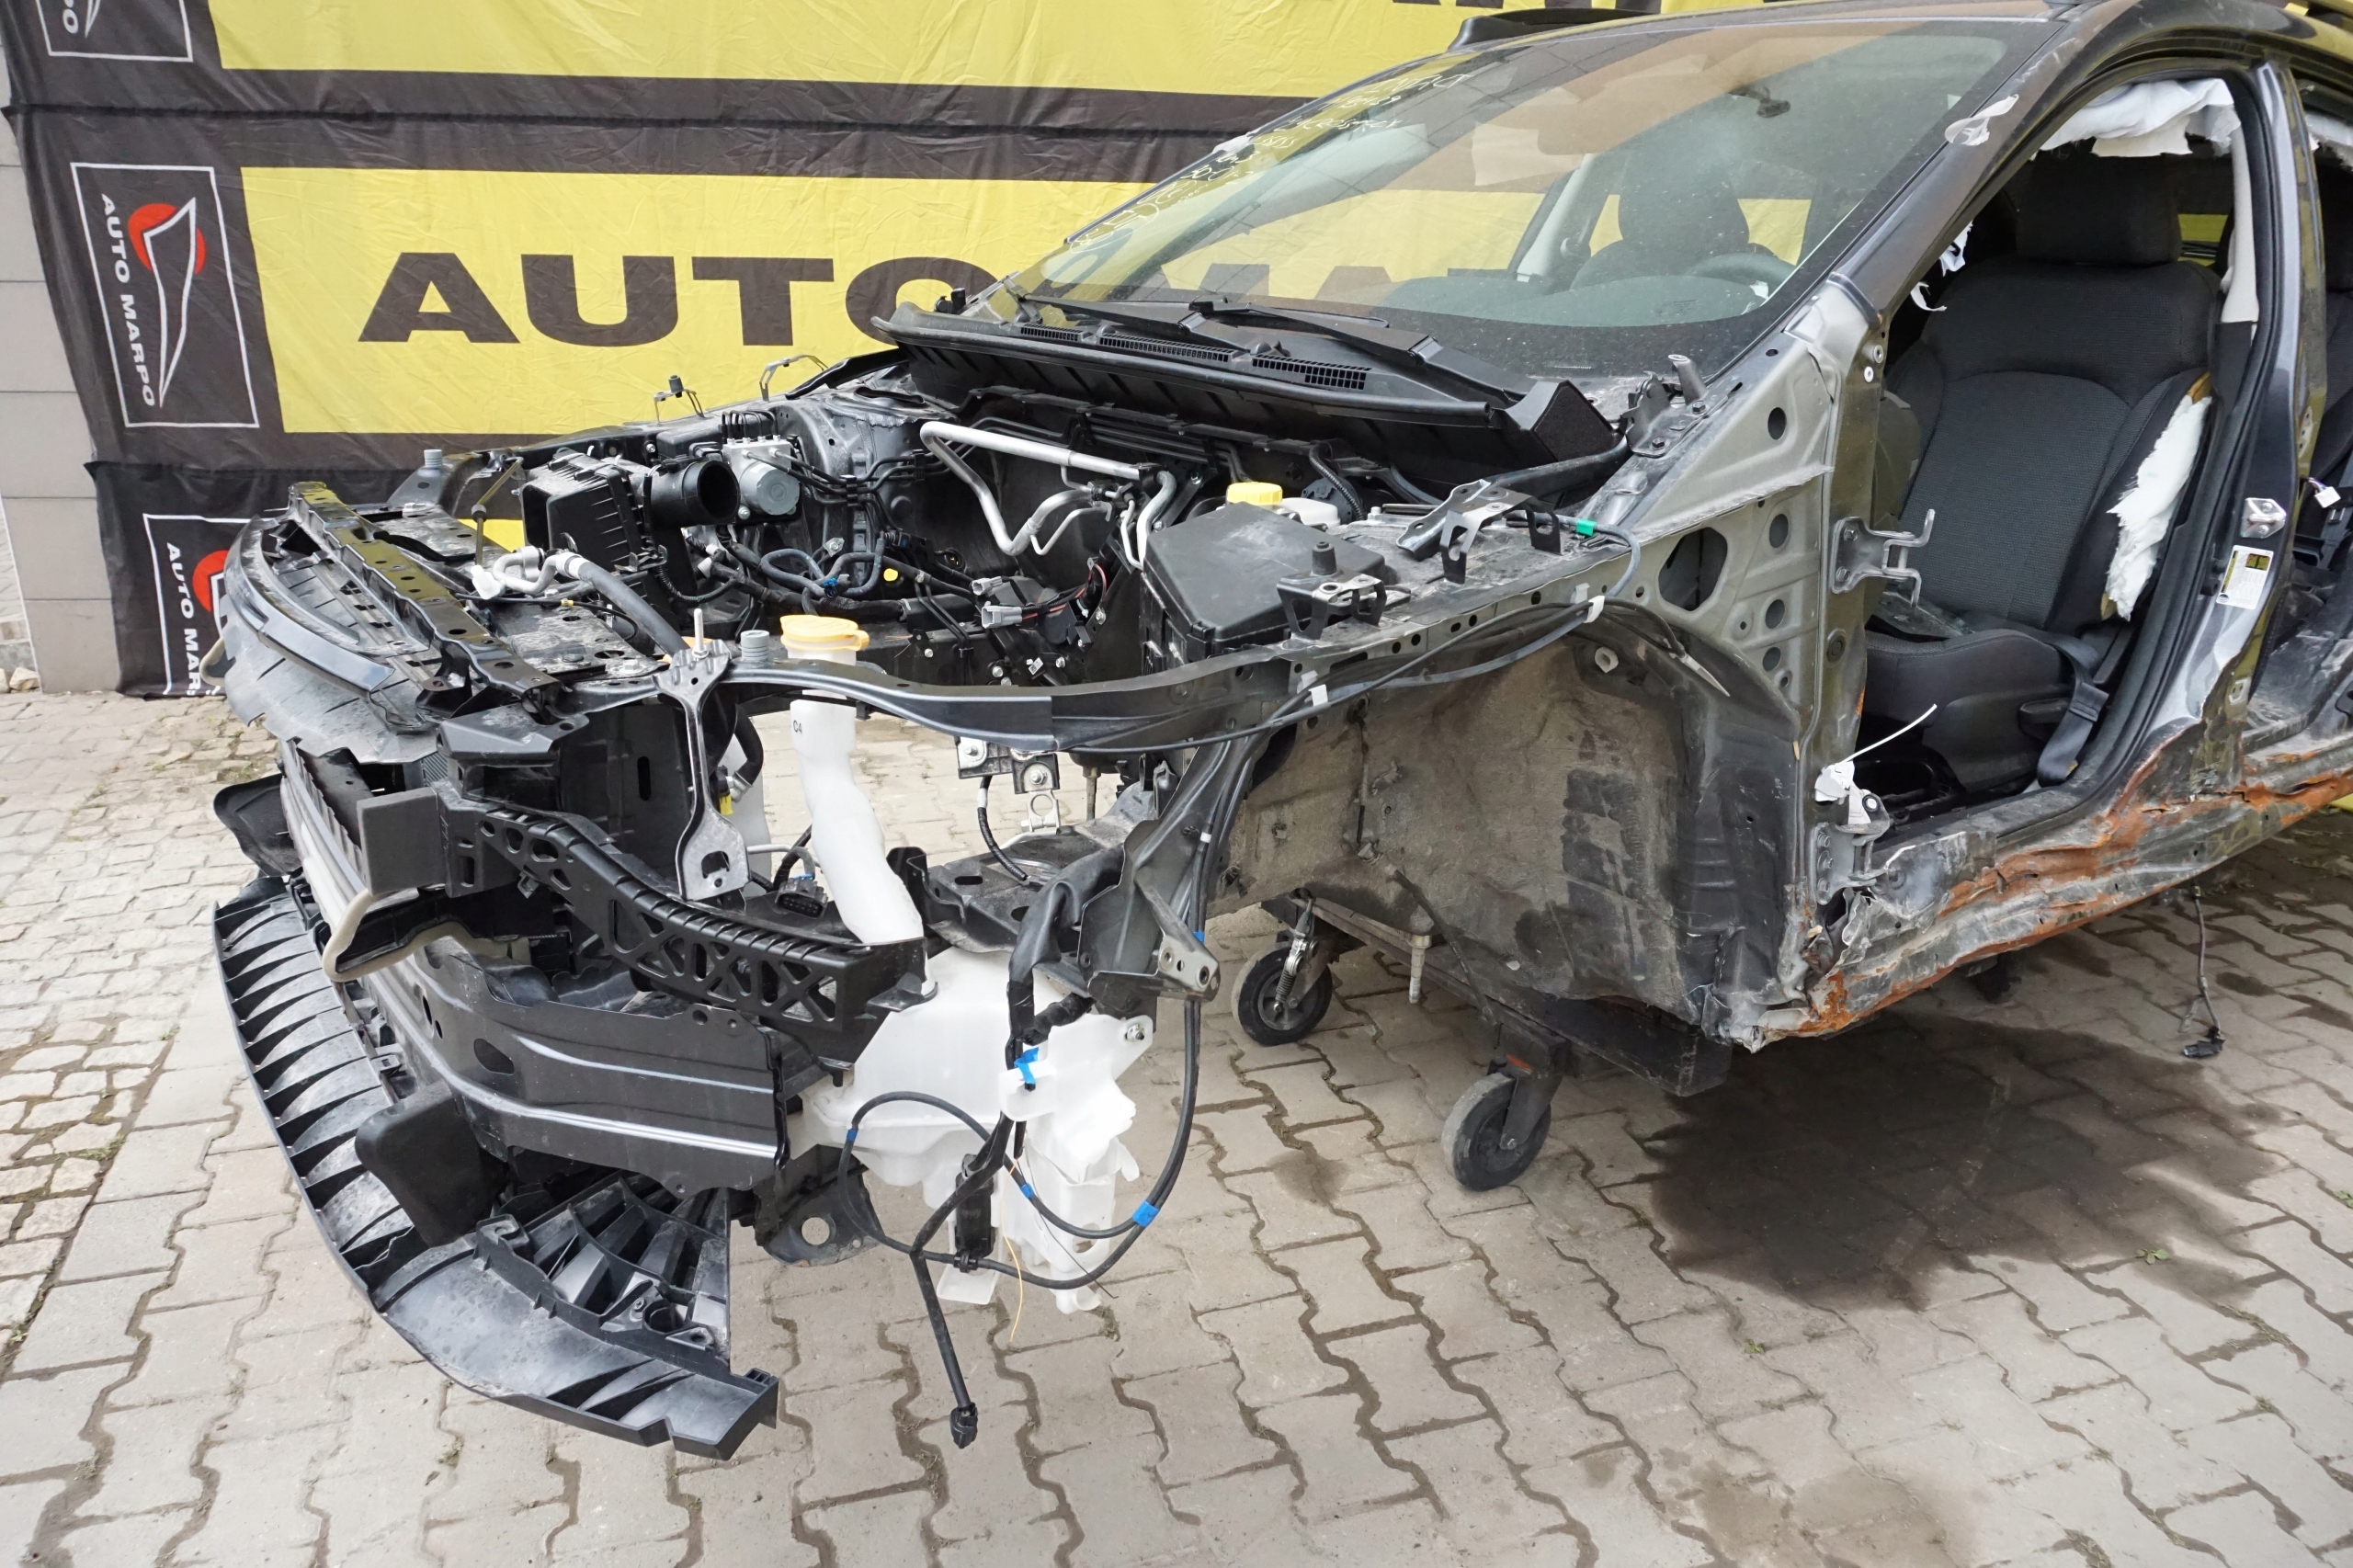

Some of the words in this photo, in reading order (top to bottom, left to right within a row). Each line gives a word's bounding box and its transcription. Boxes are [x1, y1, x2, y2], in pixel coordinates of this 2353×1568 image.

[101, 193, 131, 284] AUTO
[120, 294, 155, 407] MARPO
[358, 252, 999, 347] AUTO
[166, 541, 195, 619] AUTO
[184, 628, 202, 696] MAR
